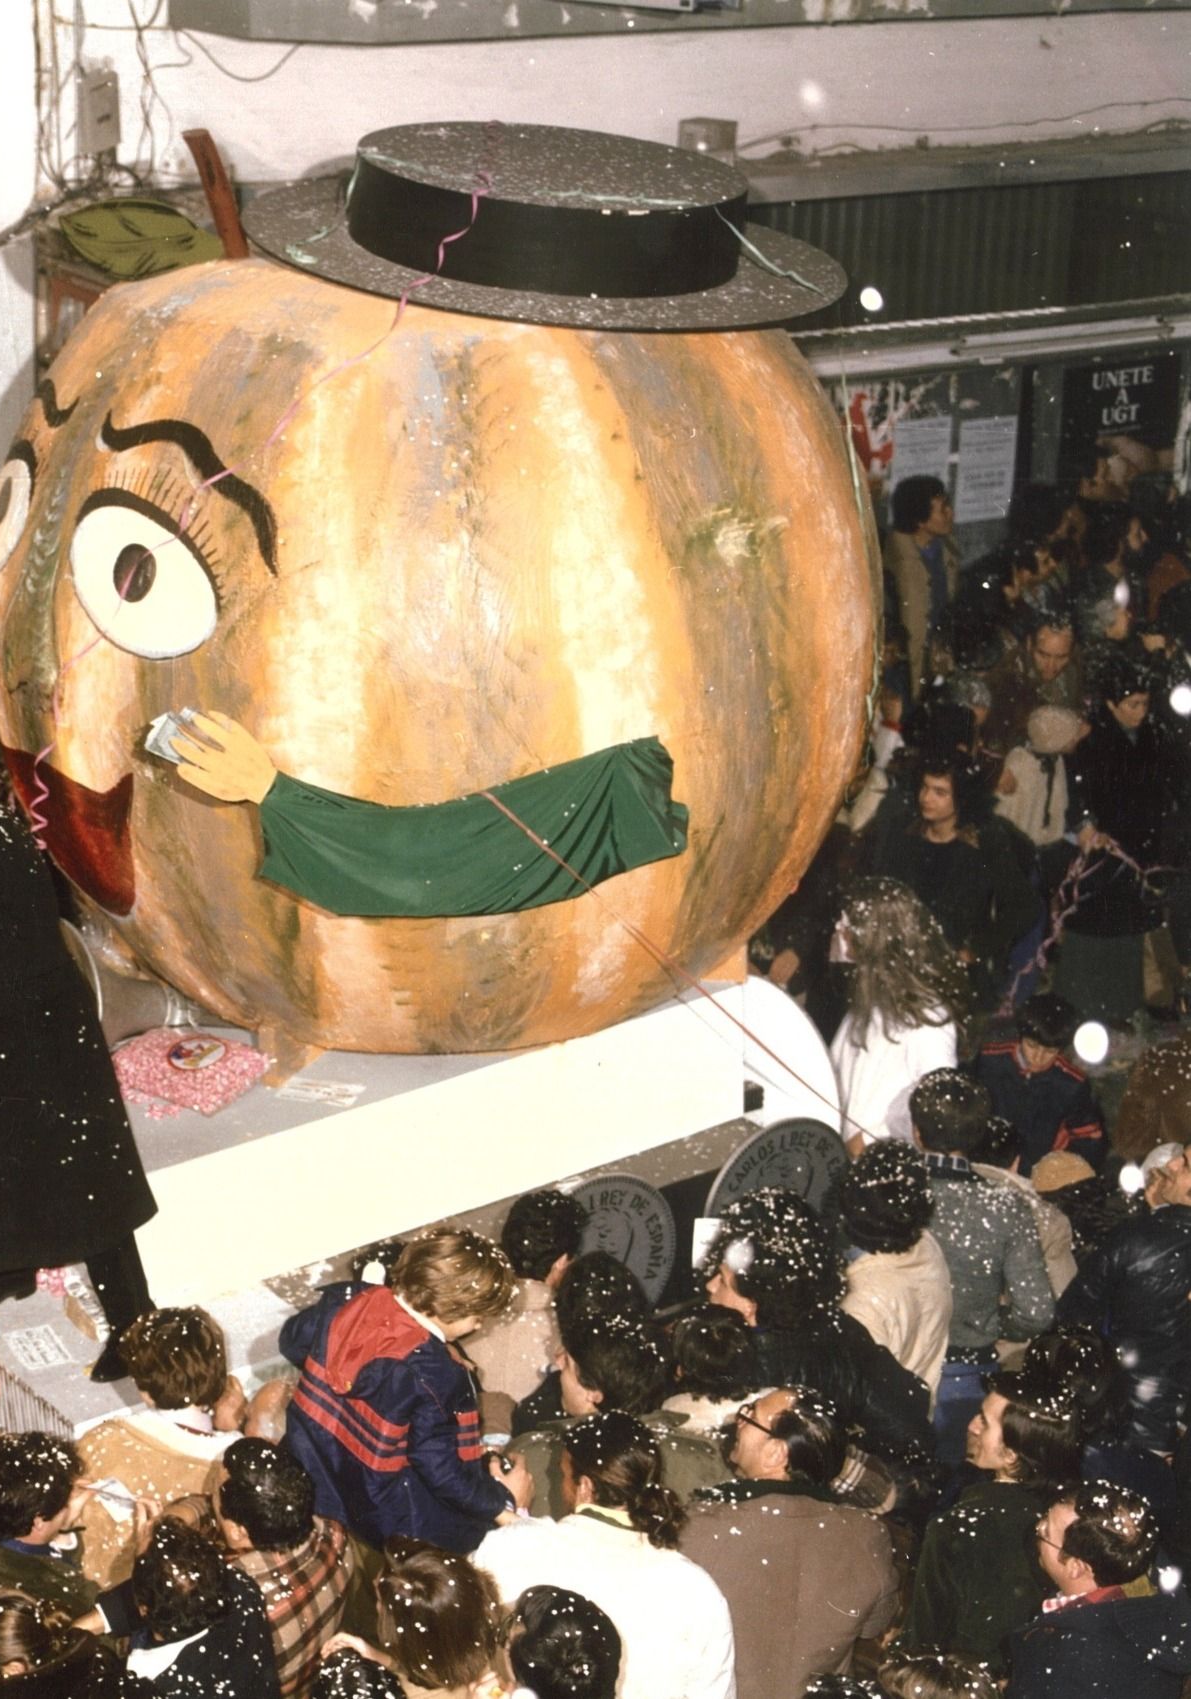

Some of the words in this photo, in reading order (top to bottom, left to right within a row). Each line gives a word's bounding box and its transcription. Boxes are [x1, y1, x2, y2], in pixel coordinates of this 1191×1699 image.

[1092, 365, 1154, 391] UNETE
[1115, 388, 1129, 405] A
[1102, 403, 1141, 426] UGT
[728, 1138, 775, 1193] CARLOS
[789, 1130, 815, 1147] REY
[599, 1188, 629, 1207] REY
